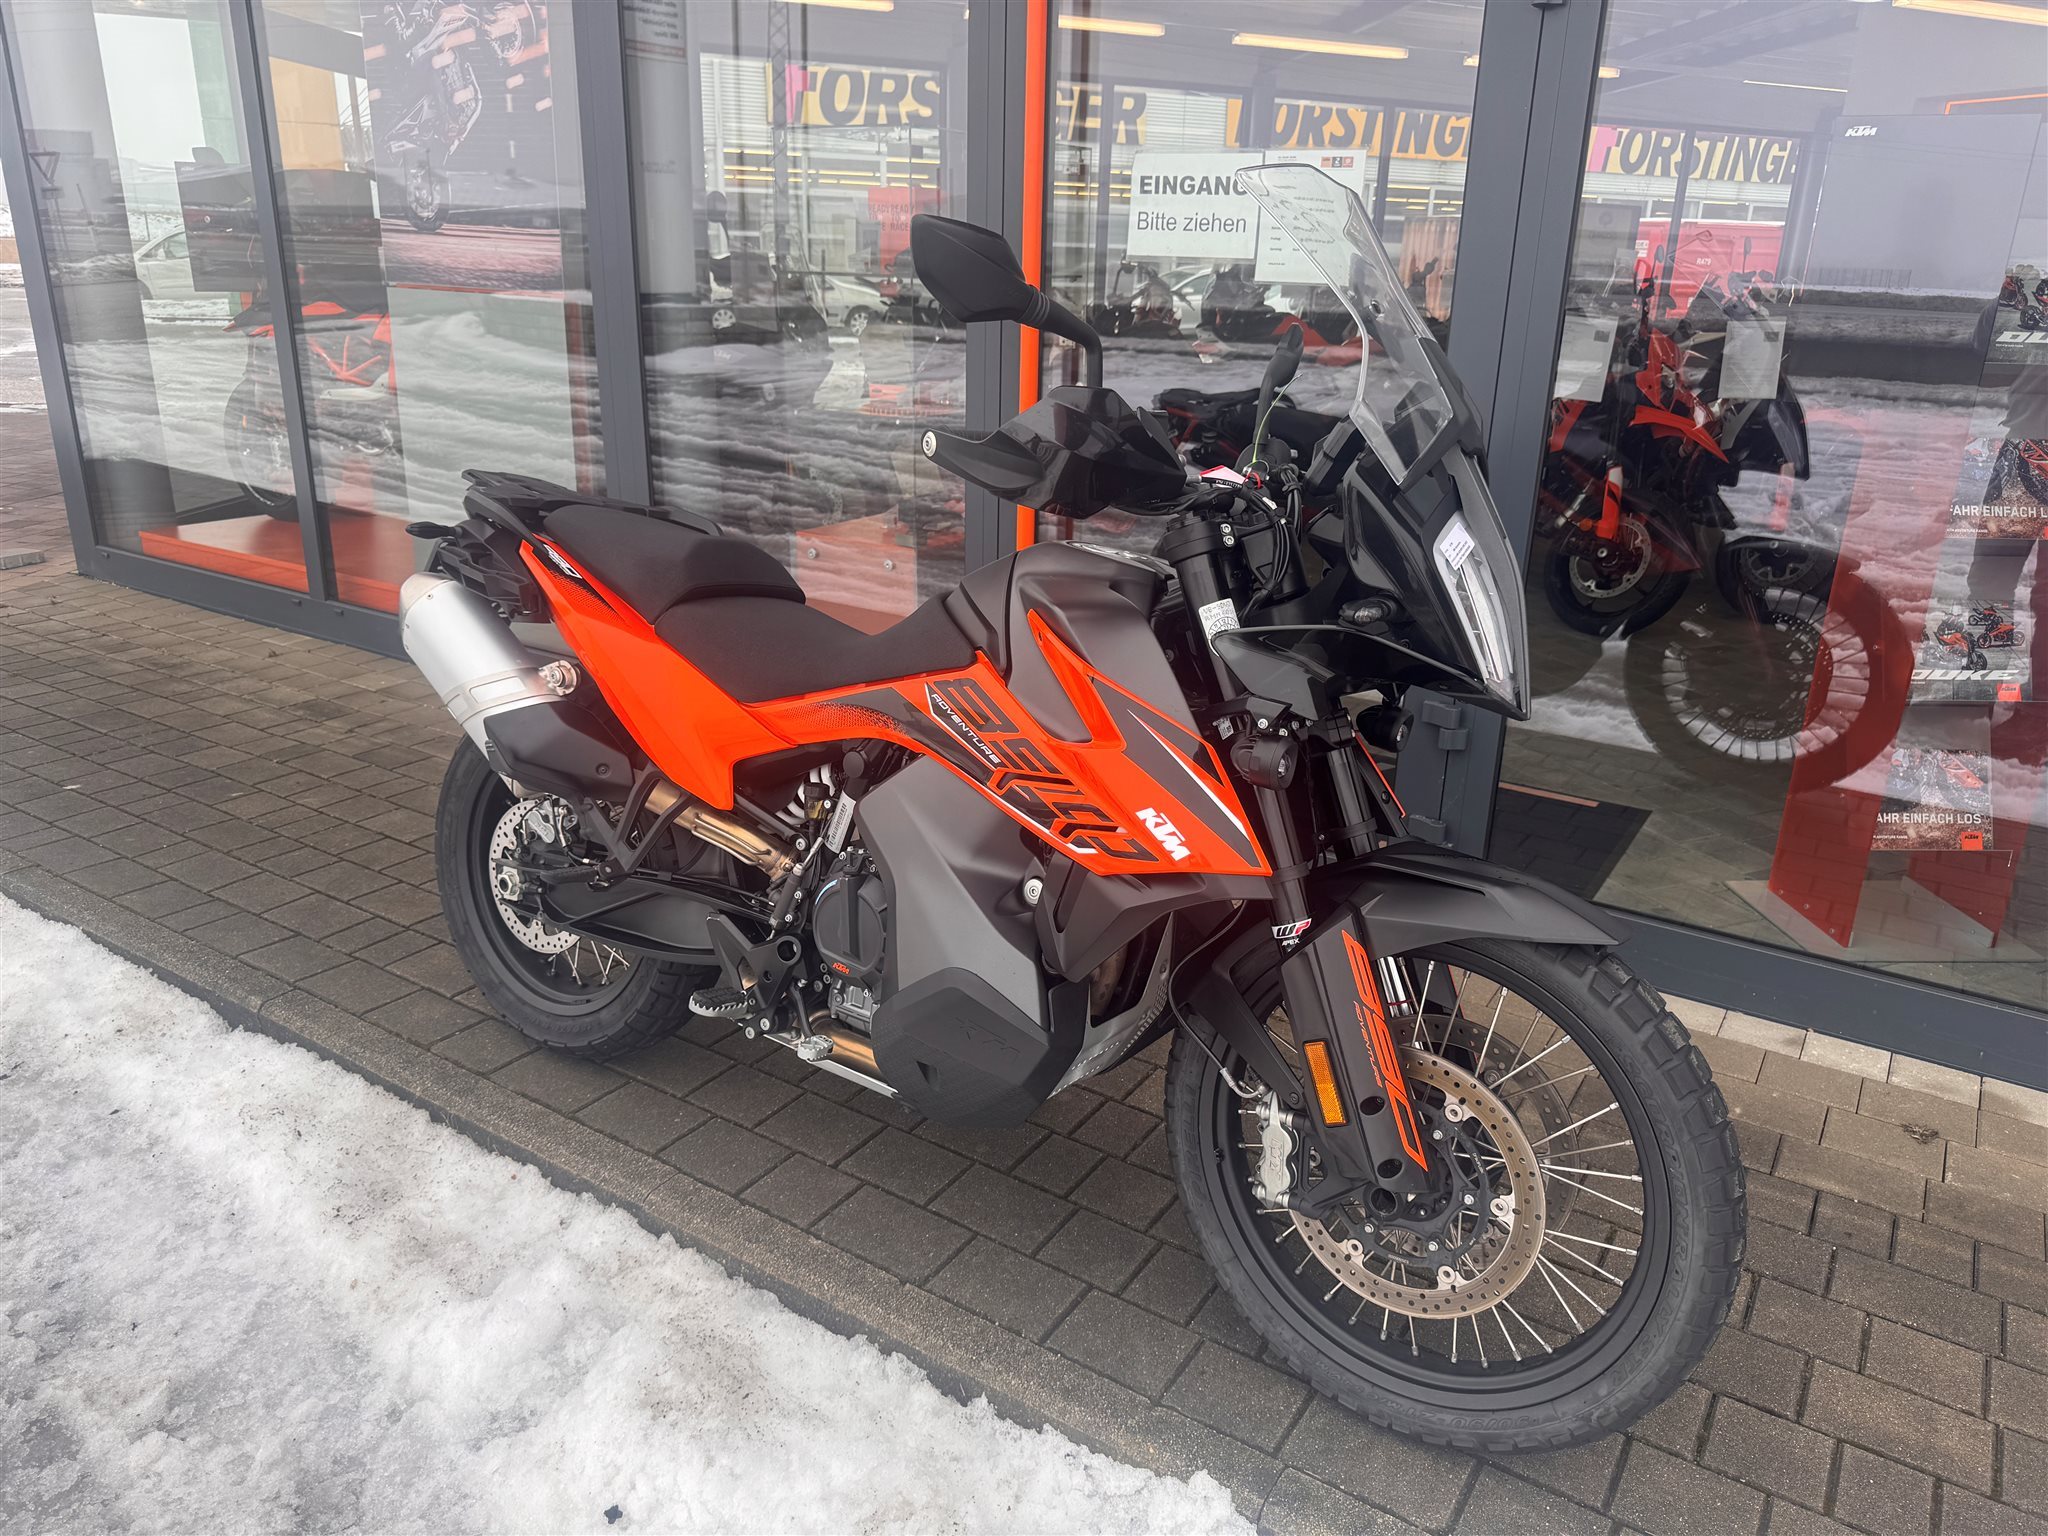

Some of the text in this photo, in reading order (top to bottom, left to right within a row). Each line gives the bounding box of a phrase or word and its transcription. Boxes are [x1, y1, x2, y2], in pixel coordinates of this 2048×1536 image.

[1845, 125, 1878, 137] KTM
[1137, 211, 1247, 233] Bitte ziehen
[1983, 506, 2037, 517] EINFACH
[931, 693, 1002, 764] ADVENTURE
[1903, 813, 1954, 824] EINFACH
[1957, 814, 1982, 824] LOS
[1135, 807, 1192, 861] KTM
[1353, 1000, 1383, 1088] ADVENTURE
